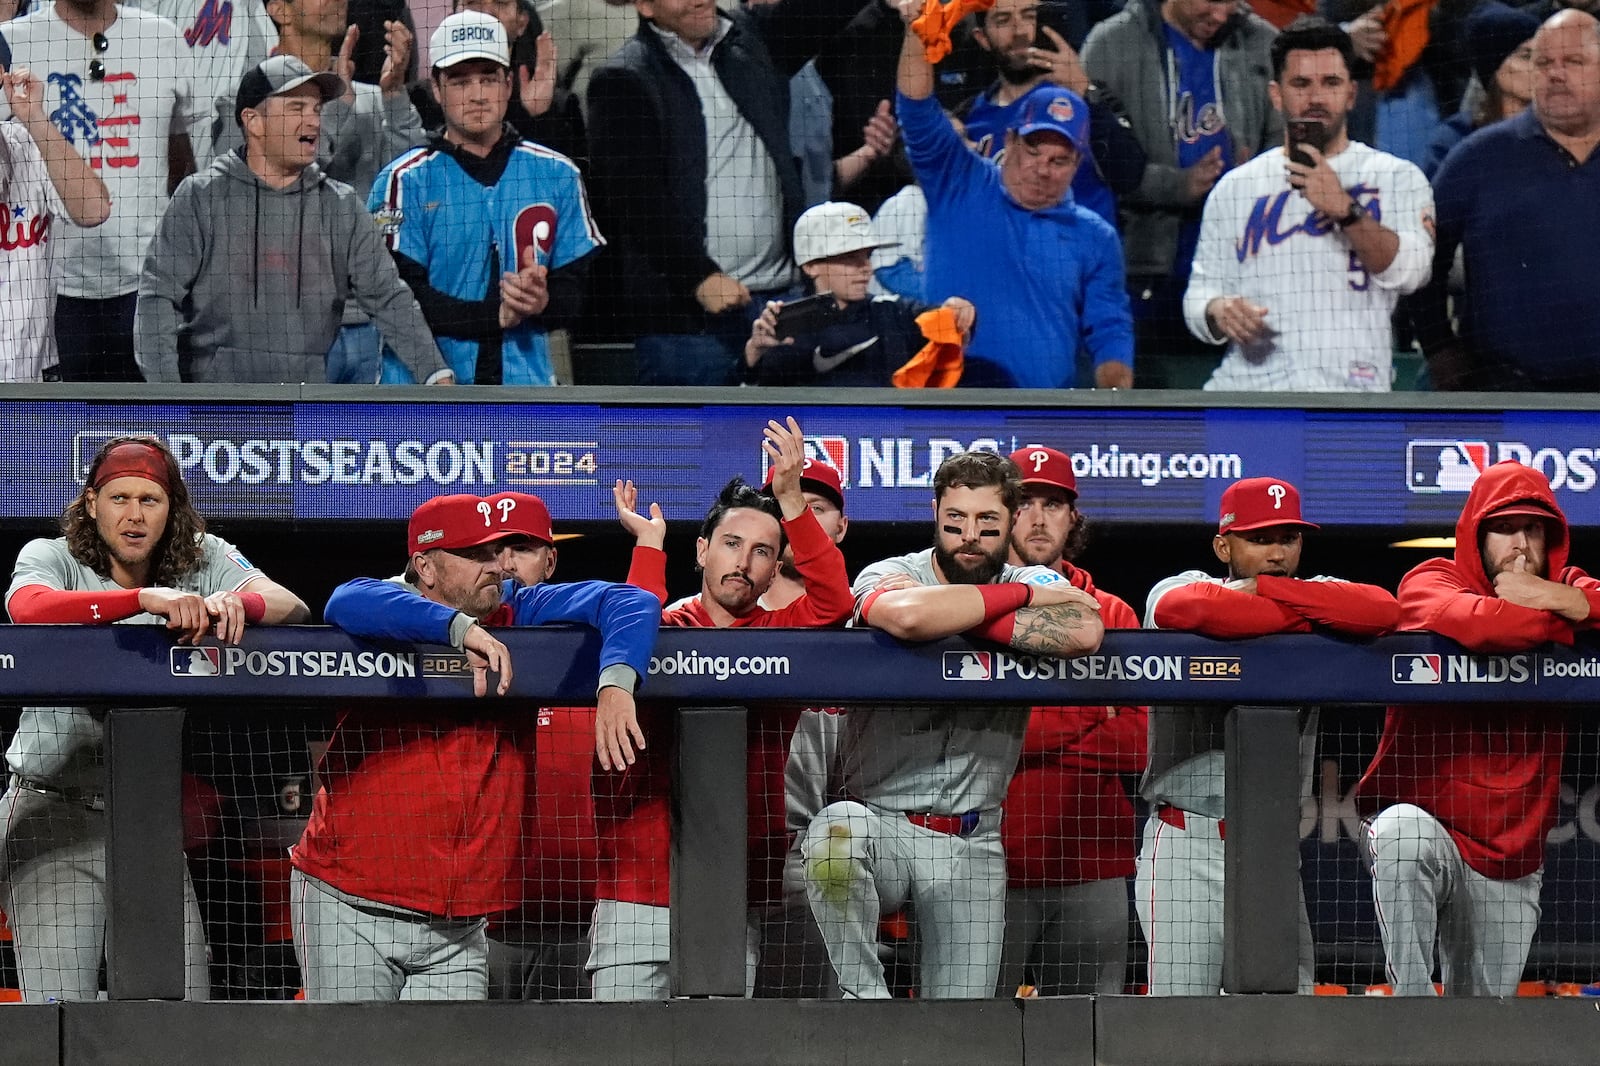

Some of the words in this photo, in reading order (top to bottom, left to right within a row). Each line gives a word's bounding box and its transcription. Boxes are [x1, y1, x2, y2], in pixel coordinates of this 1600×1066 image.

[512, 202, 559, 274] P
[1348, 250, 1369, 291] 5
[168, 434, 495, 485] POSTSEASON
[506, 451, 598, 474] 2024
[1029, 450, 1049, 473] P
[1070, 444, 1242, 486] oking.com
[1497, 441, 1600, 492] POS
[496, 498, 516, 523] P
[1267, 484, 1286, 509] P
[476, 501, 492, 527] P
[225, 648, 416, 678] POSTSEASON
[422, 659, 472, 673] 2024
[647, 650, 790, 681] ooking.com
[996, 652, 1182, 681] POSTSEASON
[1189, 662, 1241, 676] 2024
[1447, 654, 1530, 683] NLDS
[1543, 657, 1600, 678] Booki
